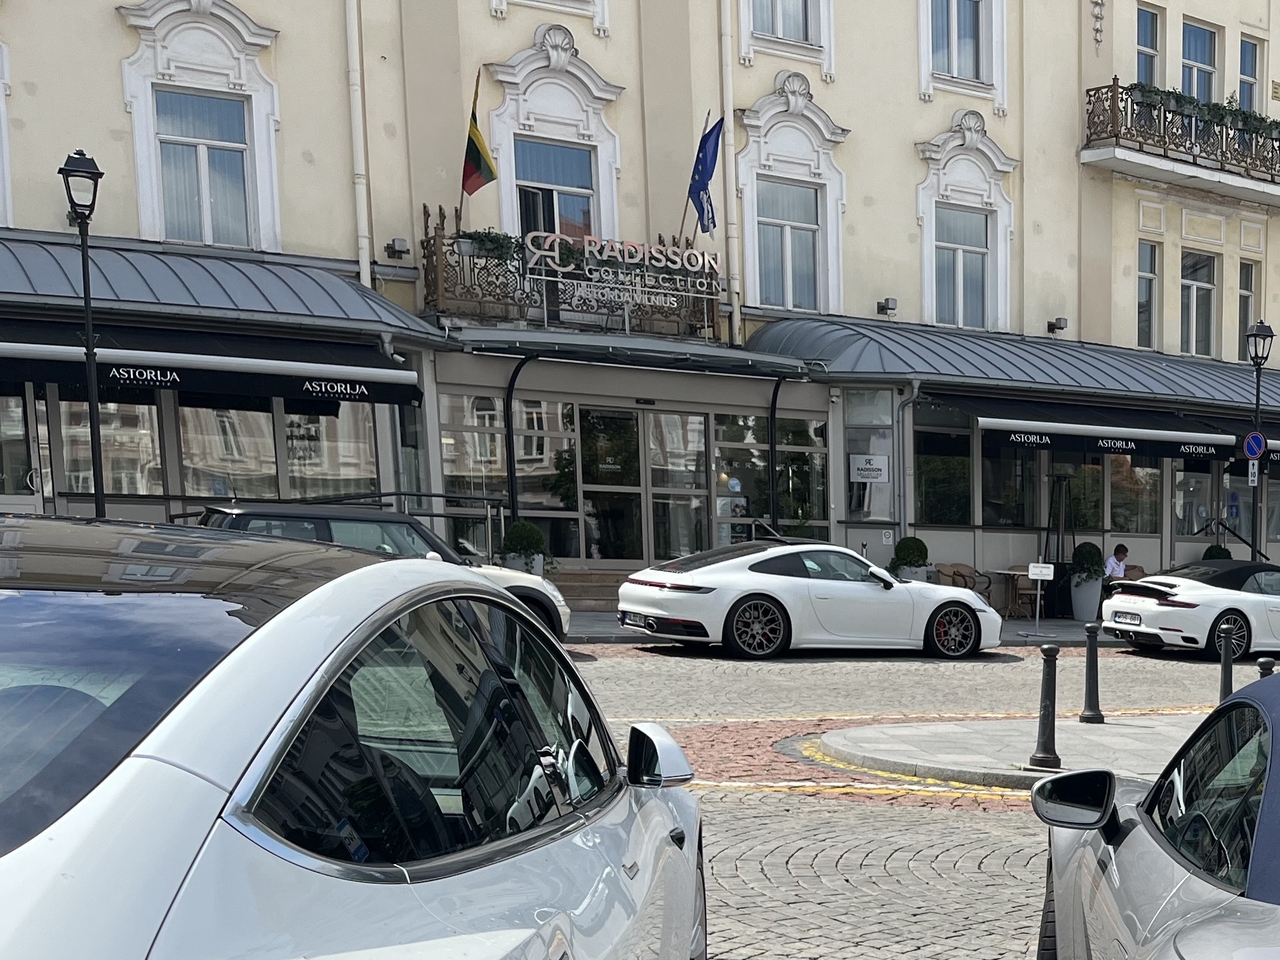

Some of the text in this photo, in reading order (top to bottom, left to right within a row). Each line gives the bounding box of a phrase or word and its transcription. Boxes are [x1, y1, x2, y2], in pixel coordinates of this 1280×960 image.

[584, 235, 722, 276] RADISSON
[109, 367, 180, 382] ASTORIJA
[302, 381, 369, 395] ASTORIJA
[1009, 433, 1051, 444] ASTORIJA
[1097, 439, 1136, 450] ASTORIJA
[1179, 444, 1216, 455] ASTORIJA
